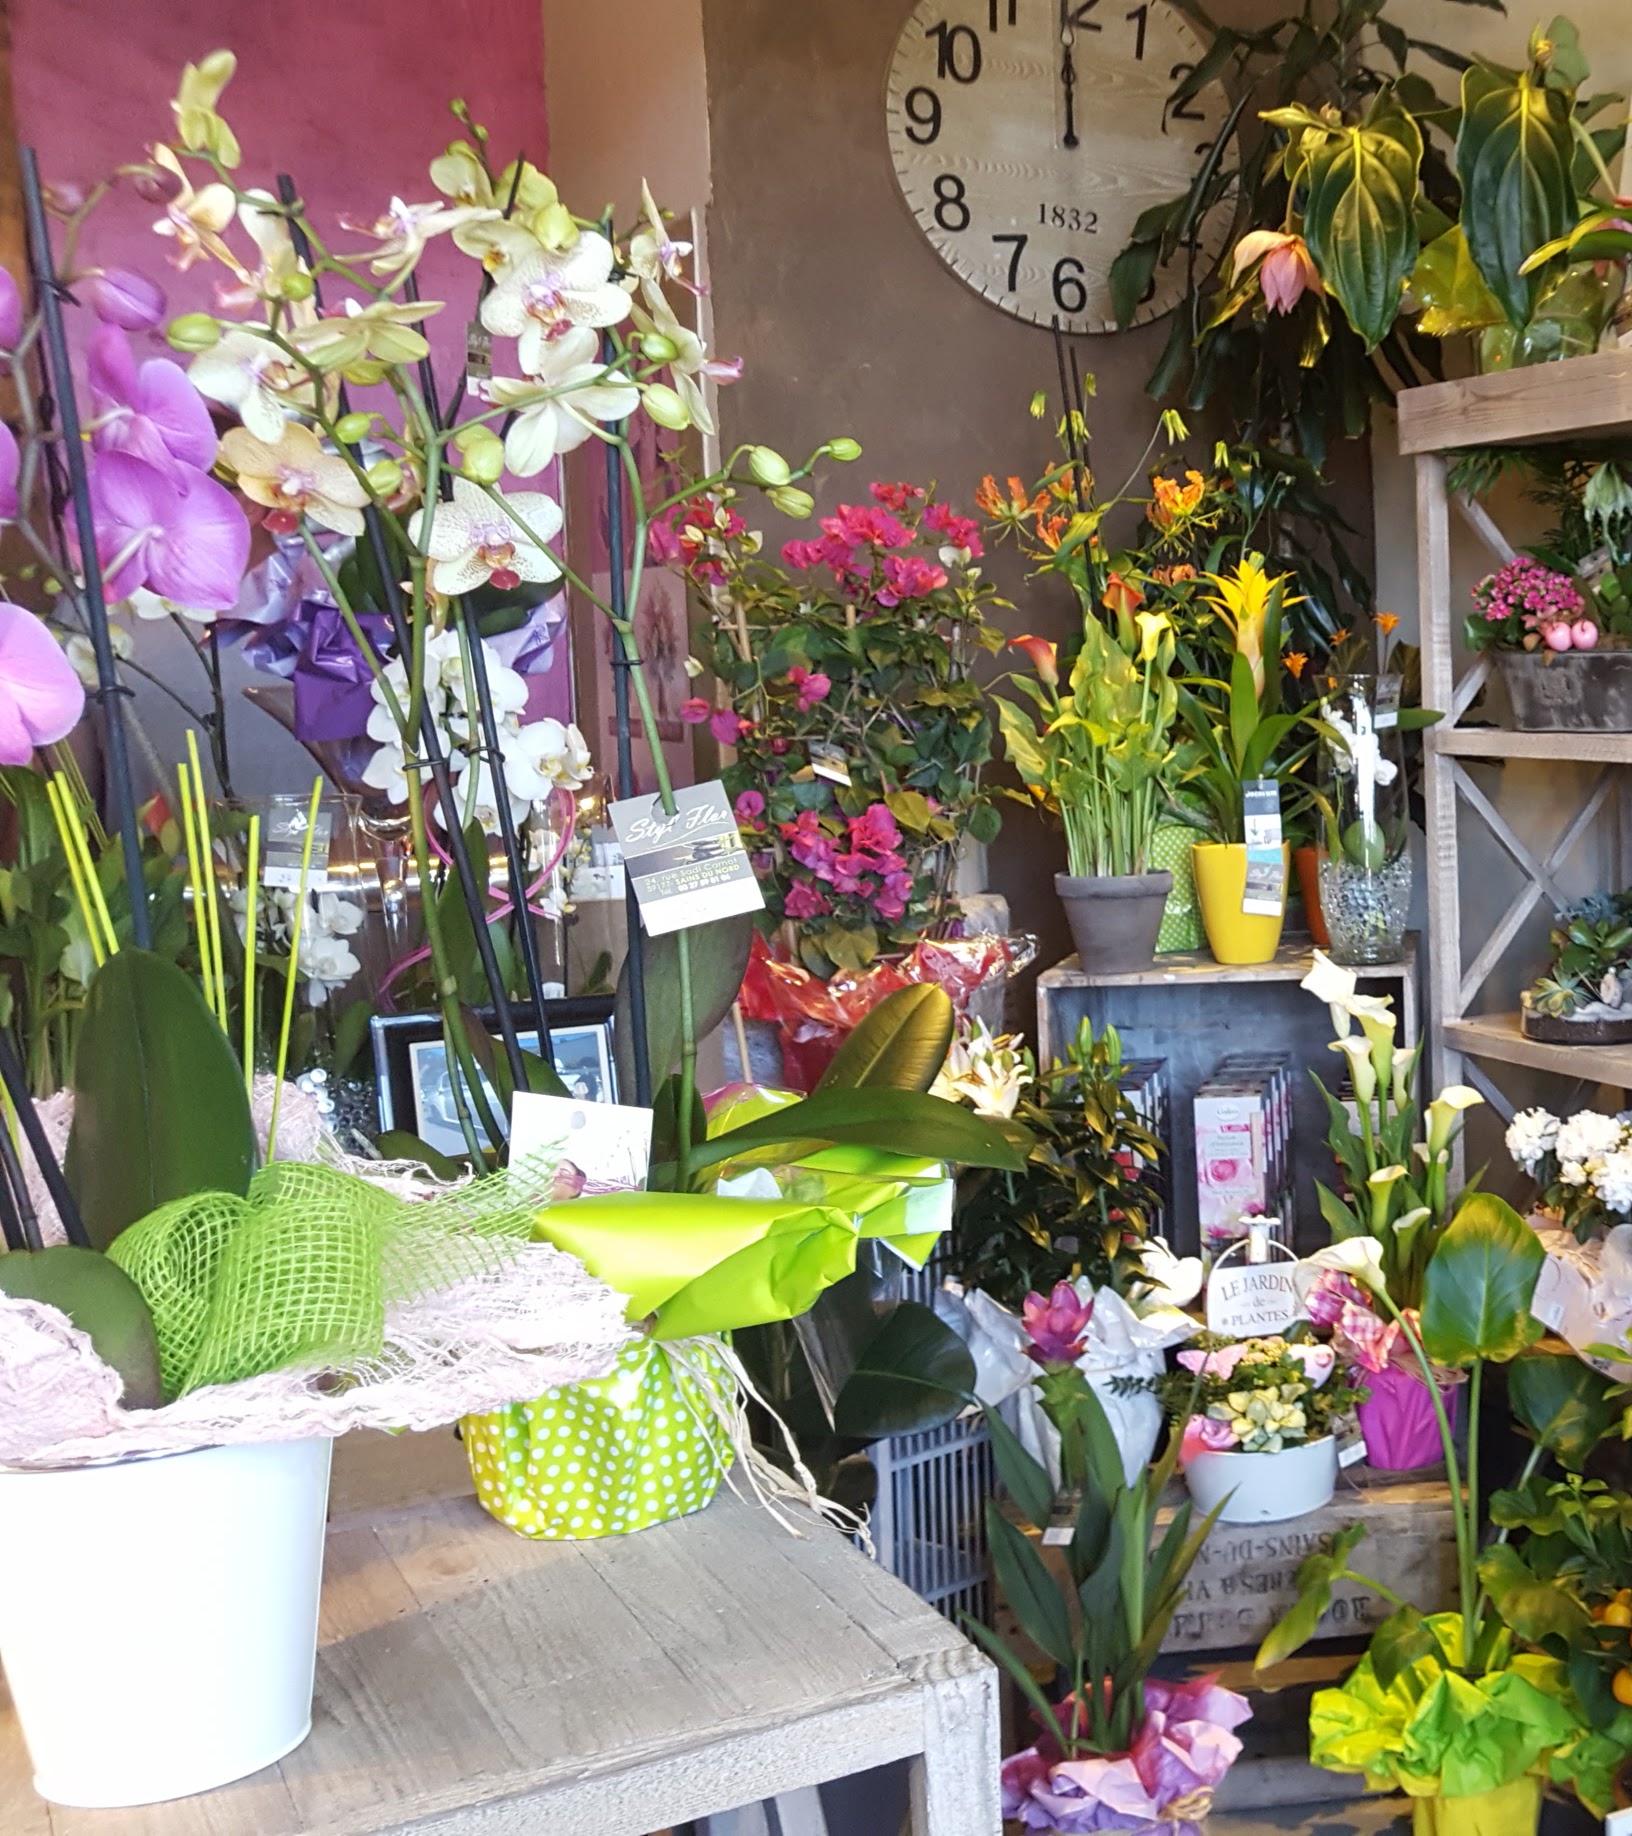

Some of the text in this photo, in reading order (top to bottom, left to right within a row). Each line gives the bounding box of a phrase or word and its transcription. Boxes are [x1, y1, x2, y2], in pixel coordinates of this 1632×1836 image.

[925, 20, 982, 84] 10
[1126, 4, 1147, 60] 1
[904, 86, 942, 145] 9
[1169, 63, 1206, 121] 2
[933, 174, 971, 232] 8
[1038, 203, 1099, 235] 1832
[992, 234, 1028, 292] 7
[1052, 257, 1088, 313] 6
[661, 872, 678, 882] rue
[680, 865, 701, 876] Sadi
[703, 858, 737, 870] Carnot
[675, 874, 700, 886] SAINS
[701, 869, 714, 879] DU
[715, 864, 740, 875] NORD
[1221, 1274, 1293, 1301] LE JARDIN
[1253, 1296, 1265, 1307] de
[1231, 1309, 1289, 1326] PLANTES
